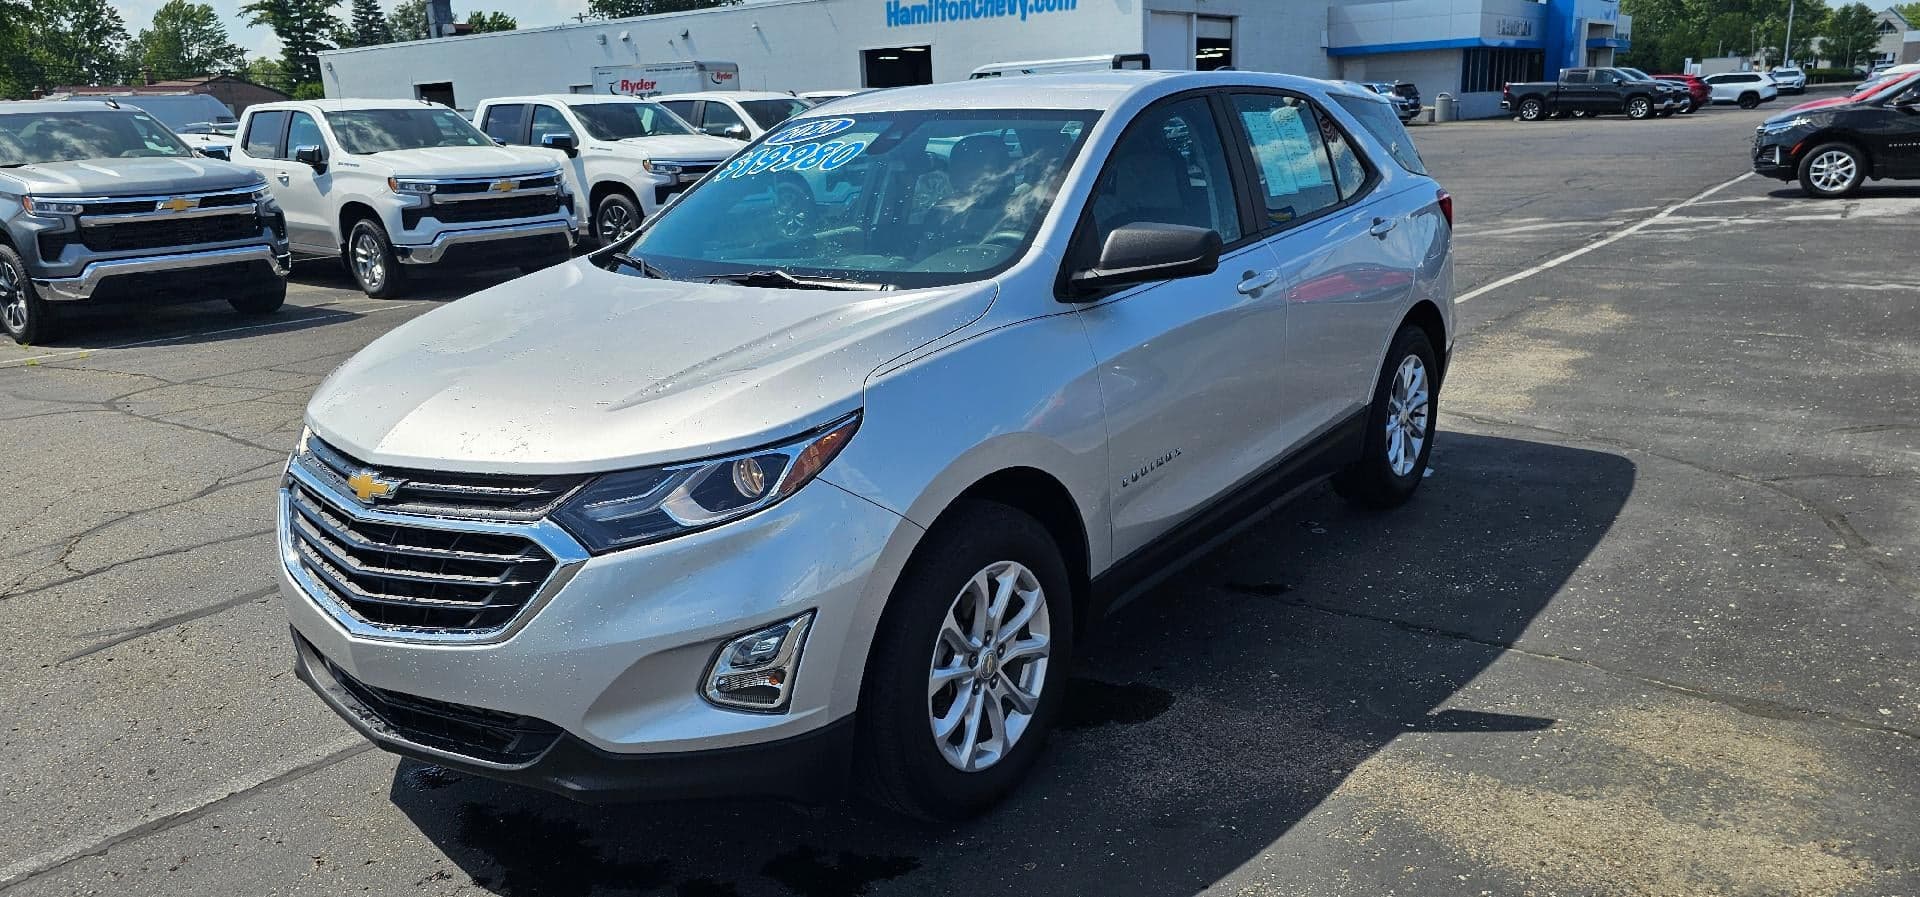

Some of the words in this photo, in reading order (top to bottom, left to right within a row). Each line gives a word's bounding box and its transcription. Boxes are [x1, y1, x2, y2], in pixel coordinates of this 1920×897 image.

[886, 0, 1078, 28] HamiltonChevy.com
[620, 79, 657, 93] Ryder
[716, 71, 733, 81] Ryder
[714, 141, 866, 183] $19980
